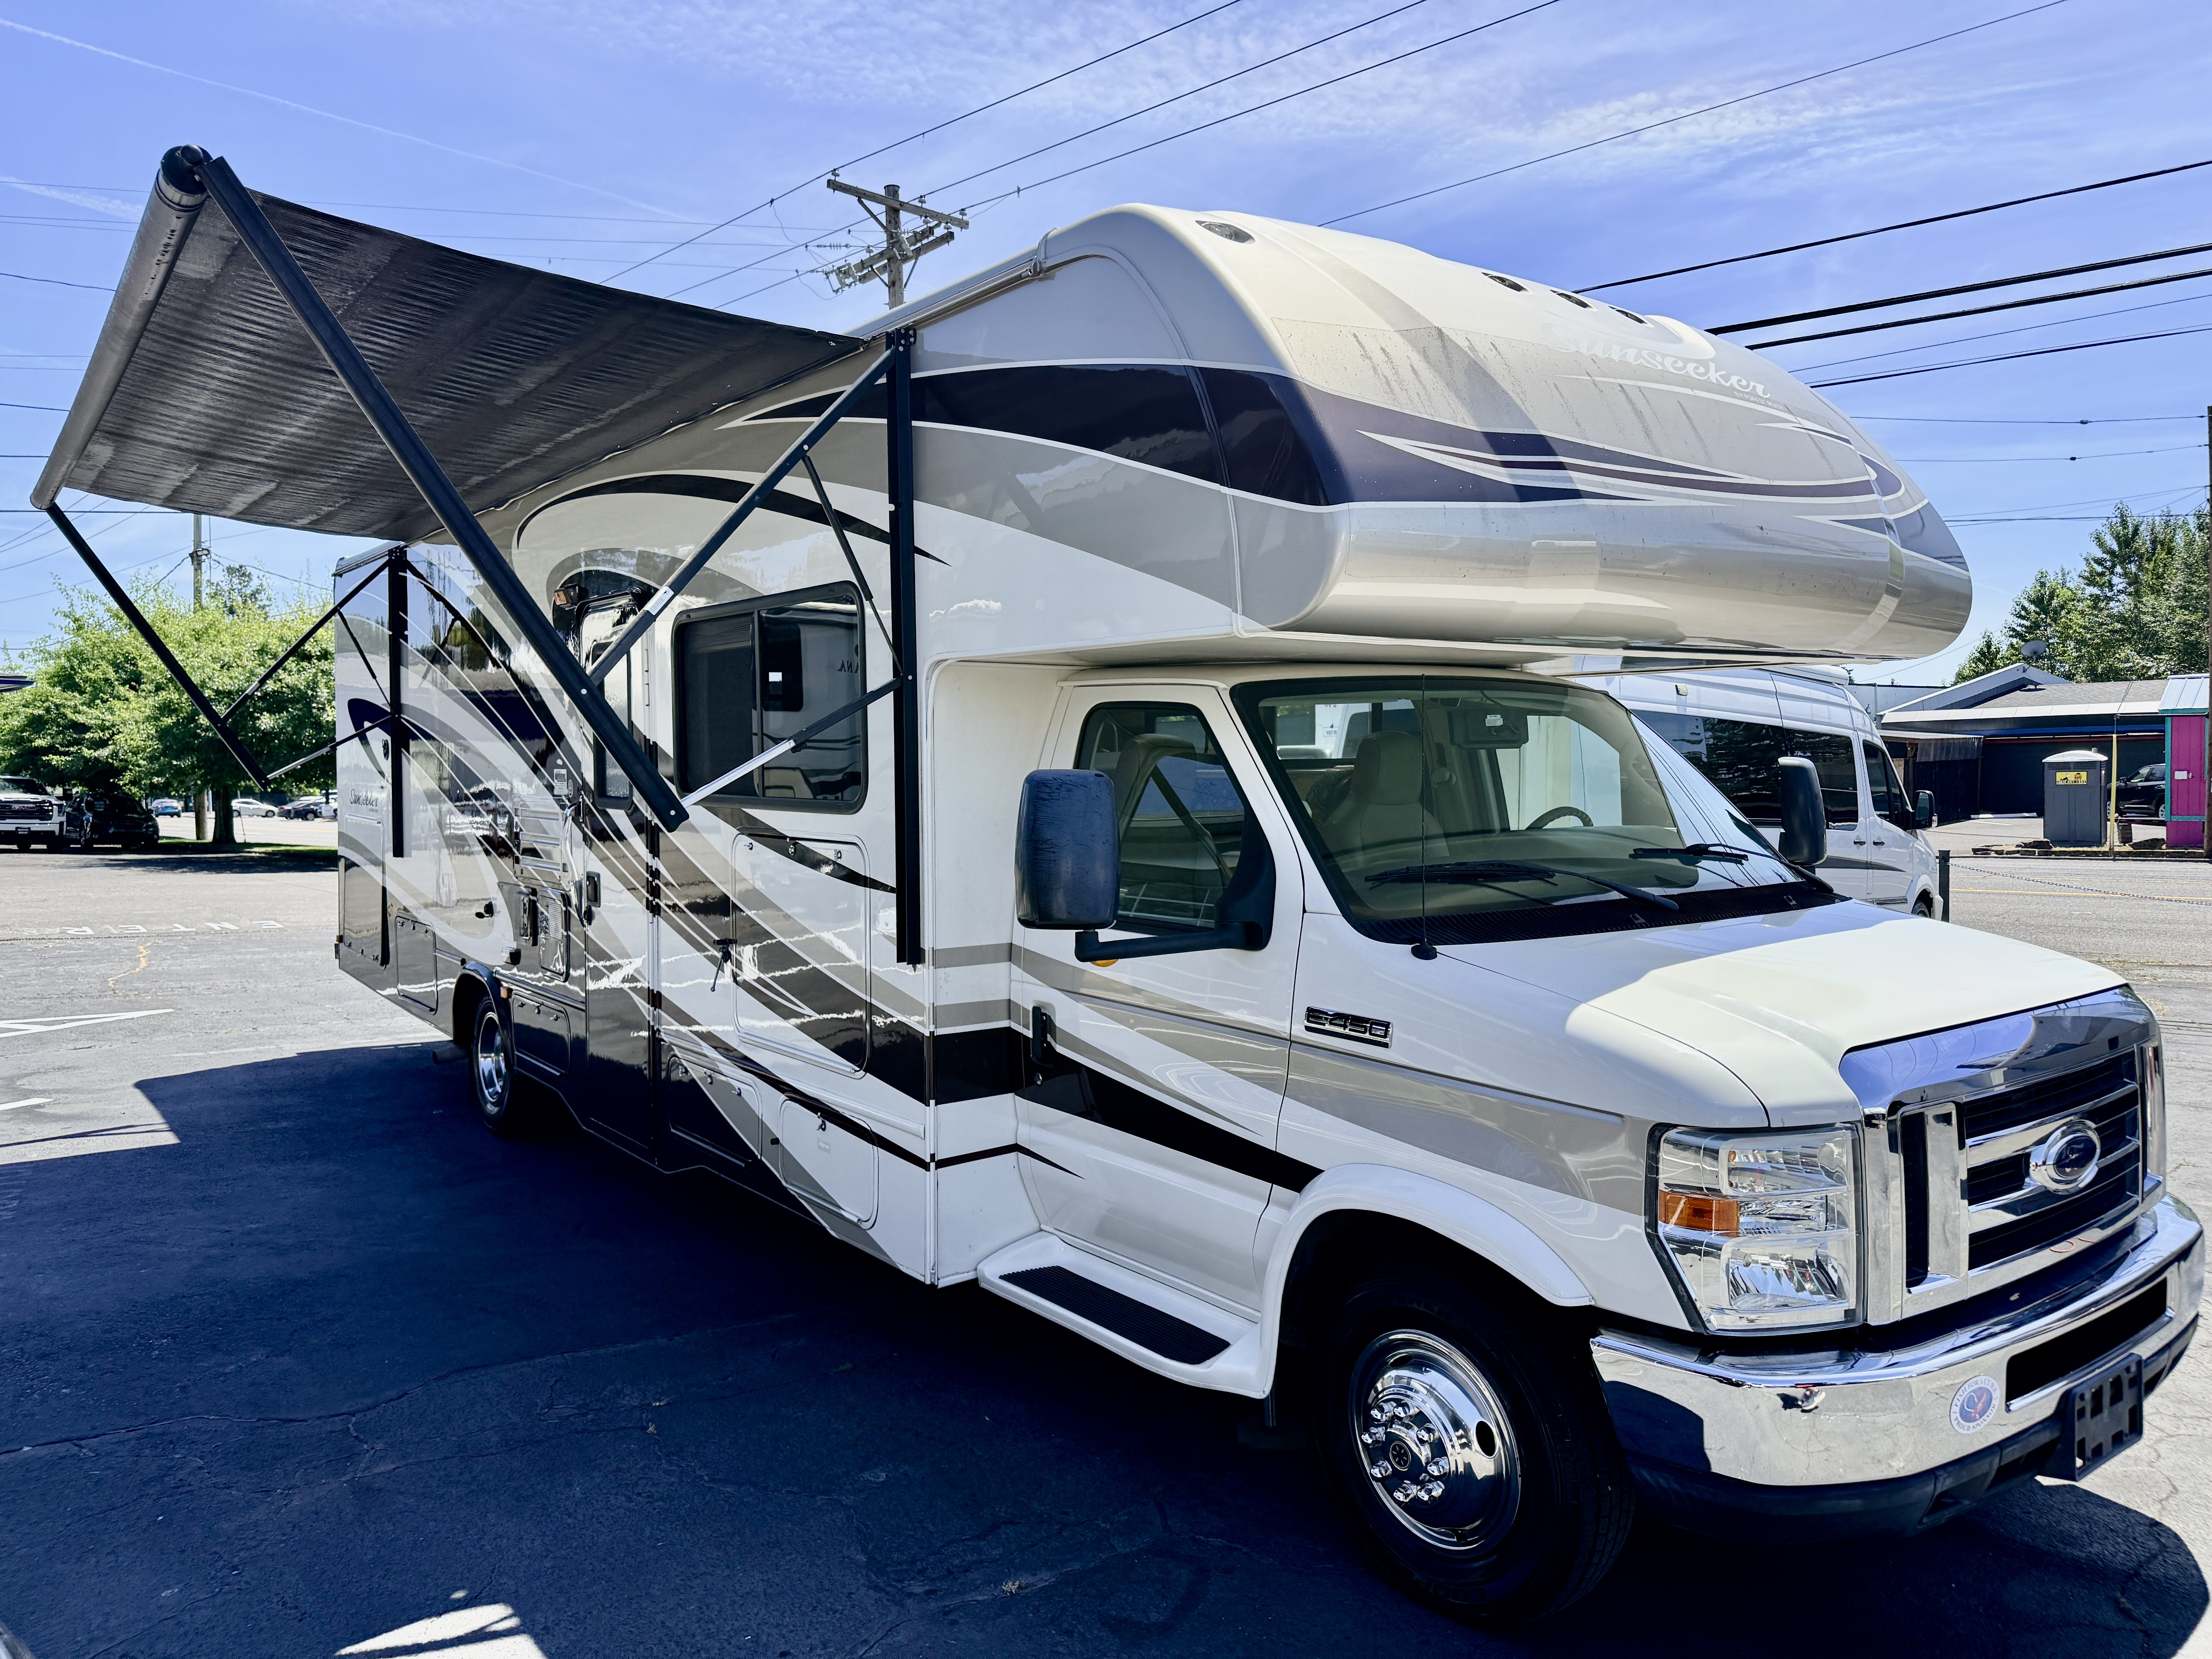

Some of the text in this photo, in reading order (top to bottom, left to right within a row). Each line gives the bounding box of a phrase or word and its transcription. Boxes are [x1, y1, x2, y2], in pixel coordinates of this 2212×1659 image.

[1541, 323, 1770, 398] Sunseeker
[62, 921, 283, 935] ENTER
[1954, 1416, 1970, 1431] PROUD
